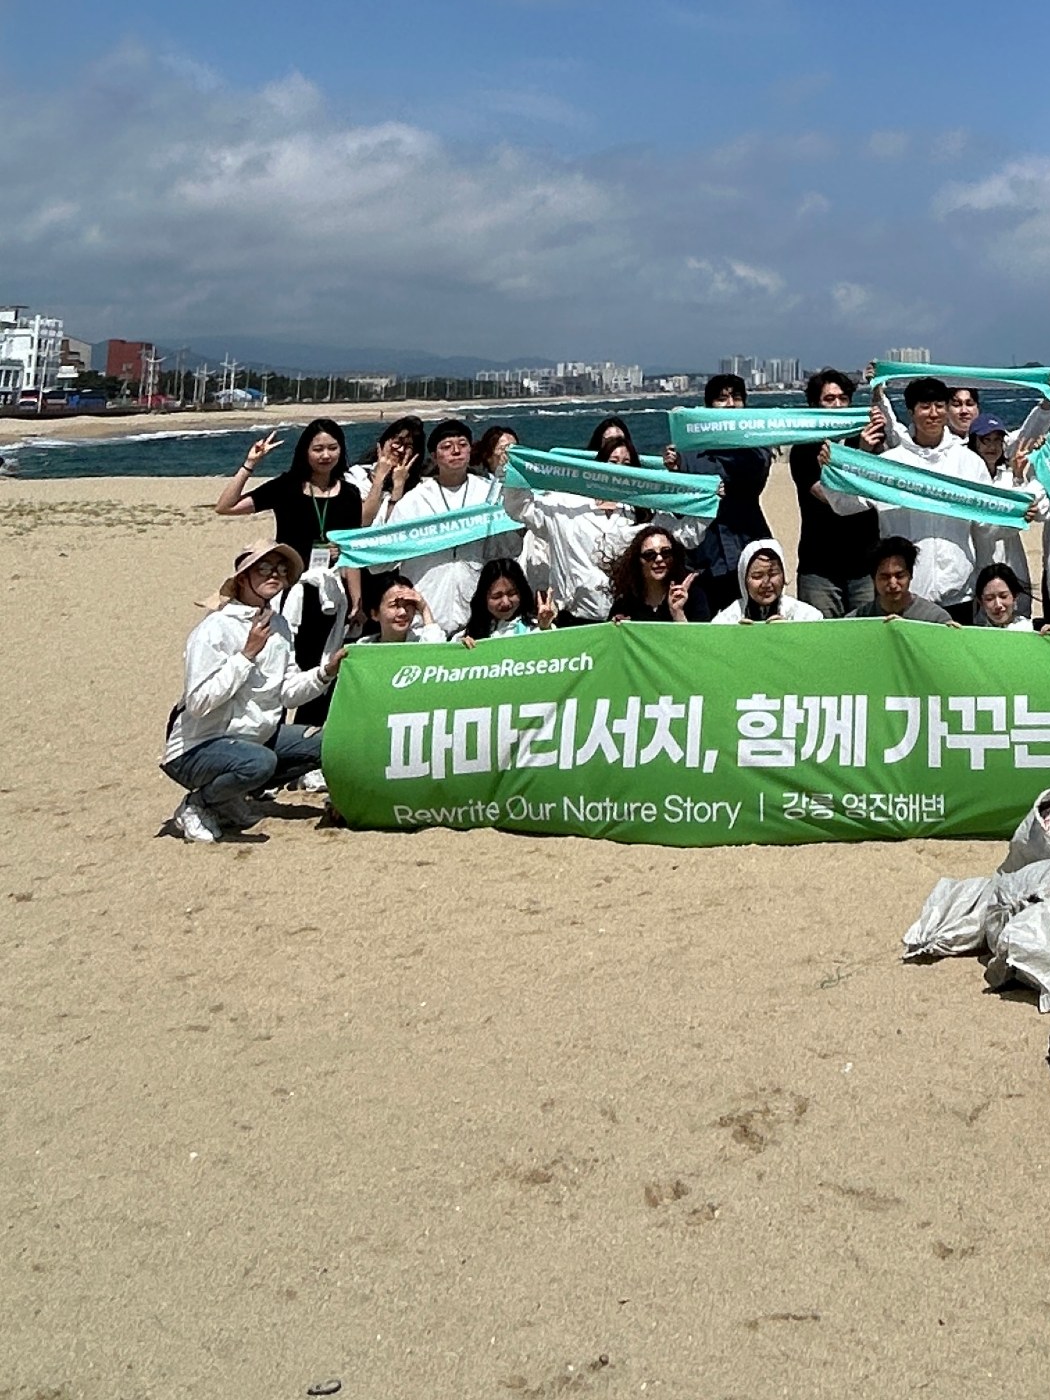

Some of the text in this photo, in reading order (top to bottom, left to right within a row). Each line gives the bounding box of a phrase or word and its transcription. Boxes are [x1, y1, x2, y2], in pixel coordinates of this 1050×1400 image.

[686, 419, 736, 433] REWRITE
[738, 419, 765, 430] OUR
[582, 471, 609, 484] OUR
[408, 523, 439, 540] OUR
[422, 652, 594, 684] PharmaResearch
[386, 696, 718, 779] 파마리서치,
[734, 693, 867, 768] 함께
[394, 792, 946, 829] Rewrite Our Nature Story 강릉 영진해변
